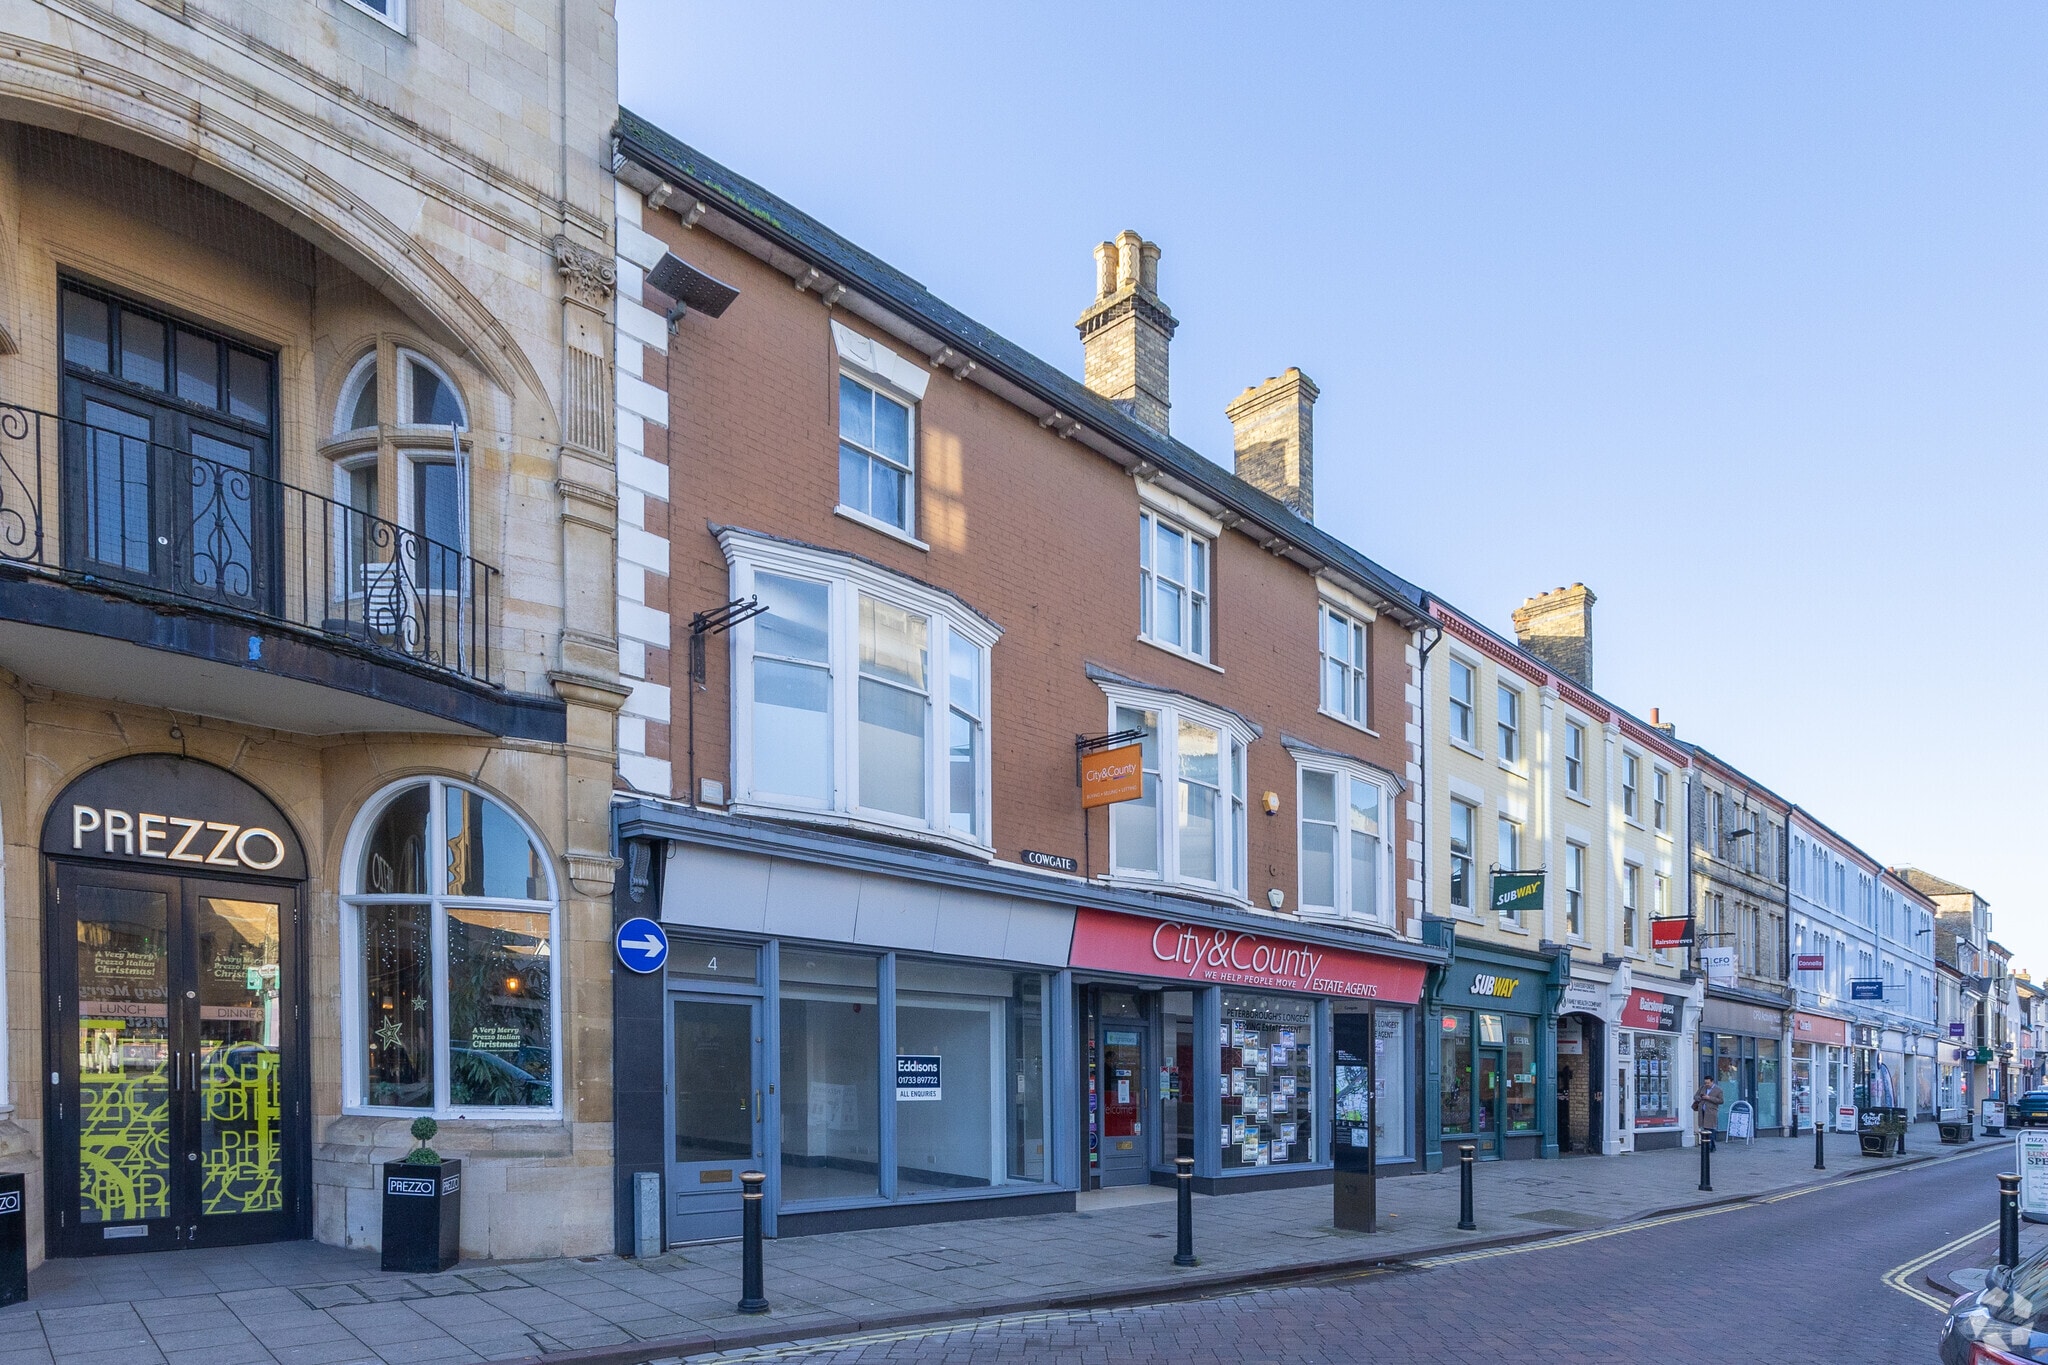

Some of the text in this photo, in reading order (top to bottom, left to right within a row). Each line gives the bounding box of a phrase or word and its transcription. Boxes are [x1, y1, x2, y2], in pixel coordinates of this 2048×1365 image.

[1086, 763, 1136, 782] City&County
[73, 804, 285, 870] PREZZO
[1029, 852, 1071, 870] COWGATE
[1496, 881, 1541, 906] SUBWAY
[105, 951, 125, 959] Very
[1152, 921, 1323, 989] City&County
[94, 958, 156, 968] Prezzo Italian
[707, 956, 718, 971] 4
[94, 965, 156, 976] Christmas!
[1204, 970, 1297, 988] WE HELP PEOPLE MOVE
[1470, 973, 1519, 998] SUBWAY
[1312, 978, 1377, 998] ESTATE AGENTS
[100, 1004, 147, 1014] LUNCH
[217, 1008, 264, 1018] DINNER
[1226, 1008, 1309, 1022] PETERBOROUGH'S LONGEST
[1234, 1020, 1302, 1034] SERVING ESTATE AGENT
[1378, 1020, 1399, 1029] LONGEST
[1378, 1031, 1394, 1039] AGENT
[472, 1040, 521, 1048] Christmas!
[898, 1060, 938, 1072] Eddisons
[898, 1076, 938, 1084] 01733 897722
[391, 1180, 431, 1193] PREZZO
[443, 1178, 458, 1191] PREZZO
